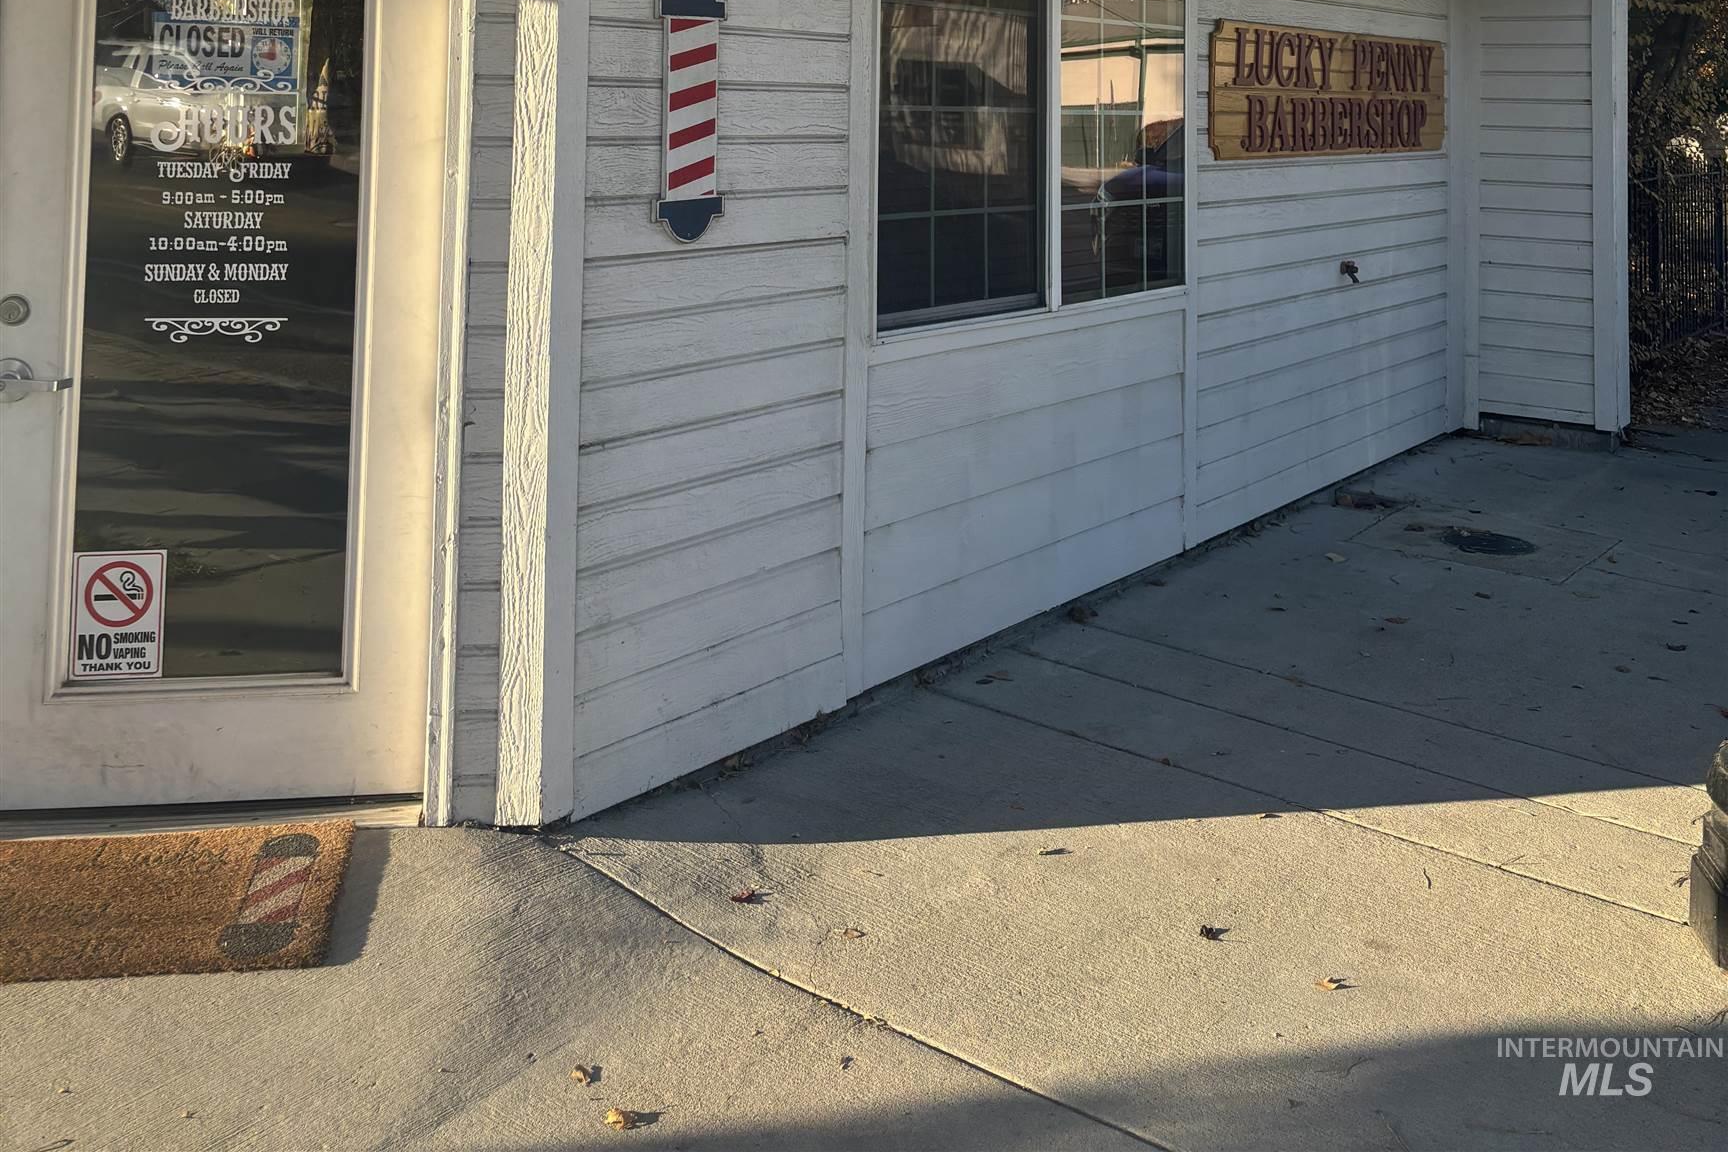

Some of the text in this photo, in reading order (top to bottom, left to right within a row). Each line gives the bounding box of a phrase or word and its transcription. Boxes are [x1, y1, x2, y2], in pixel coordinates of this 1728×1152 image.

[252, 27, 294, 36] WILL RETURN
[159, 23, 246, 59] CLOSED
[214, 61, 244, 74] Again
[1232, 27, 1435, 92] LUCKY PENNY
[150, 104, 297, 153] HOURS
[1246, 95, 1427, 152] BARBERSHOP
[162, 191, 215, 205] 9:00am
[231, 189, 285, 206] 5:00pm
[184, 211, 264, 229] SATURDAY
[144, 263, 289, 283] SUNDAY & MONDAY
[193, 289, 240, 304] CLOSED
[77, 631, 156, 661] NO SMOKING
[113, 647, 147, 659] VAPING
[81, 661, 151, 672] THANK YOU
